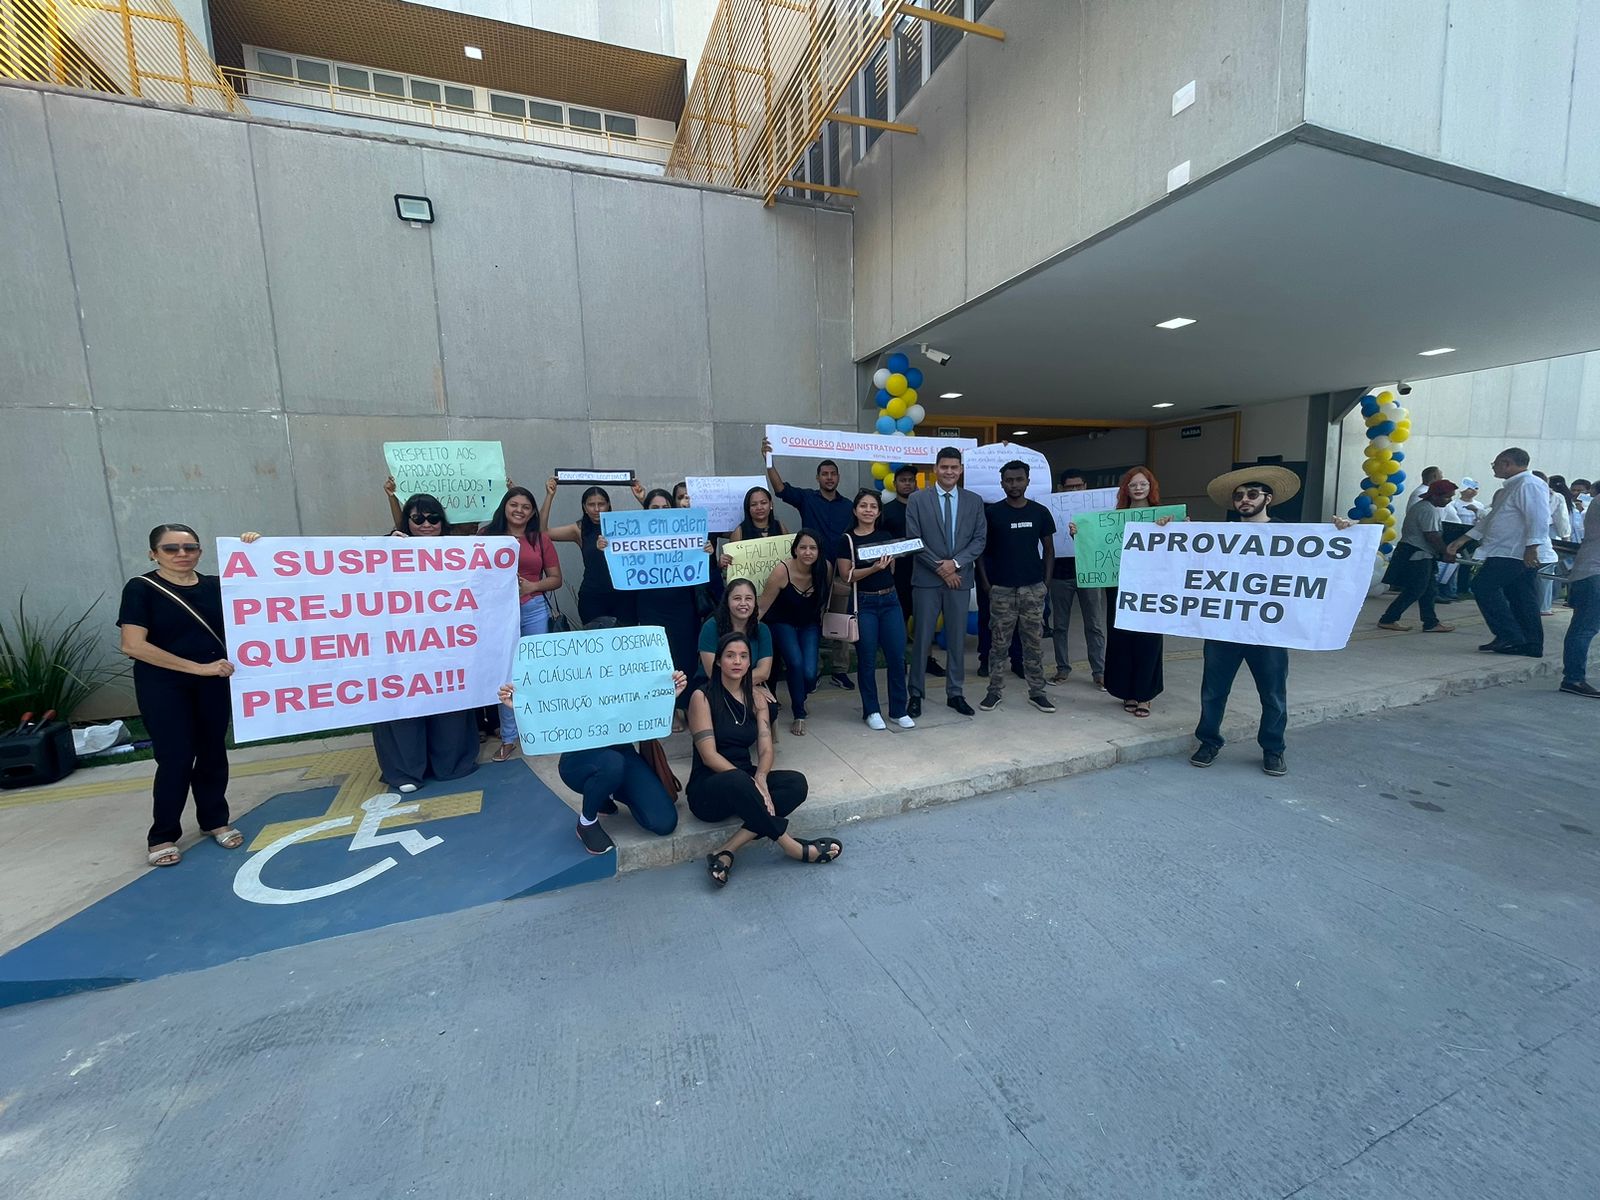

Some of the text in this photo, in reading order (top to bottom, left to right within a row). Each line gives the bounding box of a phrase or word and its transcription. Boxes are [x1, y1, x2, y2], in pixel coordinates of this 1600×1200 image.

[392, 447, 477, 462] RESPEITO AOS
[781, 436, 788, 445] O
[789, 437, 835, 448] CONCURSO
[836, 440, 902, 453] ADMINISTRATIVO
[397, 463, 467, 477] APROVADOS E
[400, 479, 484, 493] CLASSIFICADOS
[464, 493, 478, 509] JÁ
[1051, 490, 1117, 512] RESPEIT
[602, 515, 706, 537] Lista em ordem
[612, 536, 703, 552] DECRESCENTE
[784, 539, 795, 555] D
[1105, 532, 1123, 545] GAS
[1124, 532, 1353, 560] APROVADOS
[222, 543, 517, 578] A SUSPENSÃO
[654, 550, 684, 565] muda
[731, 558, 779, 576] TRANSPAR
[1095, 550, 1120, 568] PAS
[626, 560, 704, 586] POSIÇÃO!
[1078, 572, 1107, 584] QUERO
[1183, 569, 1328, 600] EXIGEM
[232, 588, 479, 625] PREJUDICA
[1118, 591, 1285, 624] RESPEITO
[236, 624, 478, 668] QUEM MAIS
[518, 637, 604, 661] PRECISAMOS
[538, 665, 593, 684] CLÁUSULA
[600, 665, 614, 679] DE
[242, 669, 466, 718] PRECISA!!!
[538, 694, 593, 713] INSTRUÇÃO
[598, 691, 641, 707] NORMATIVA
[520, 732, 536, 745] NO
[540, 726, 583, 743] TÓPICO
[619, 722, 633, 734] DO
